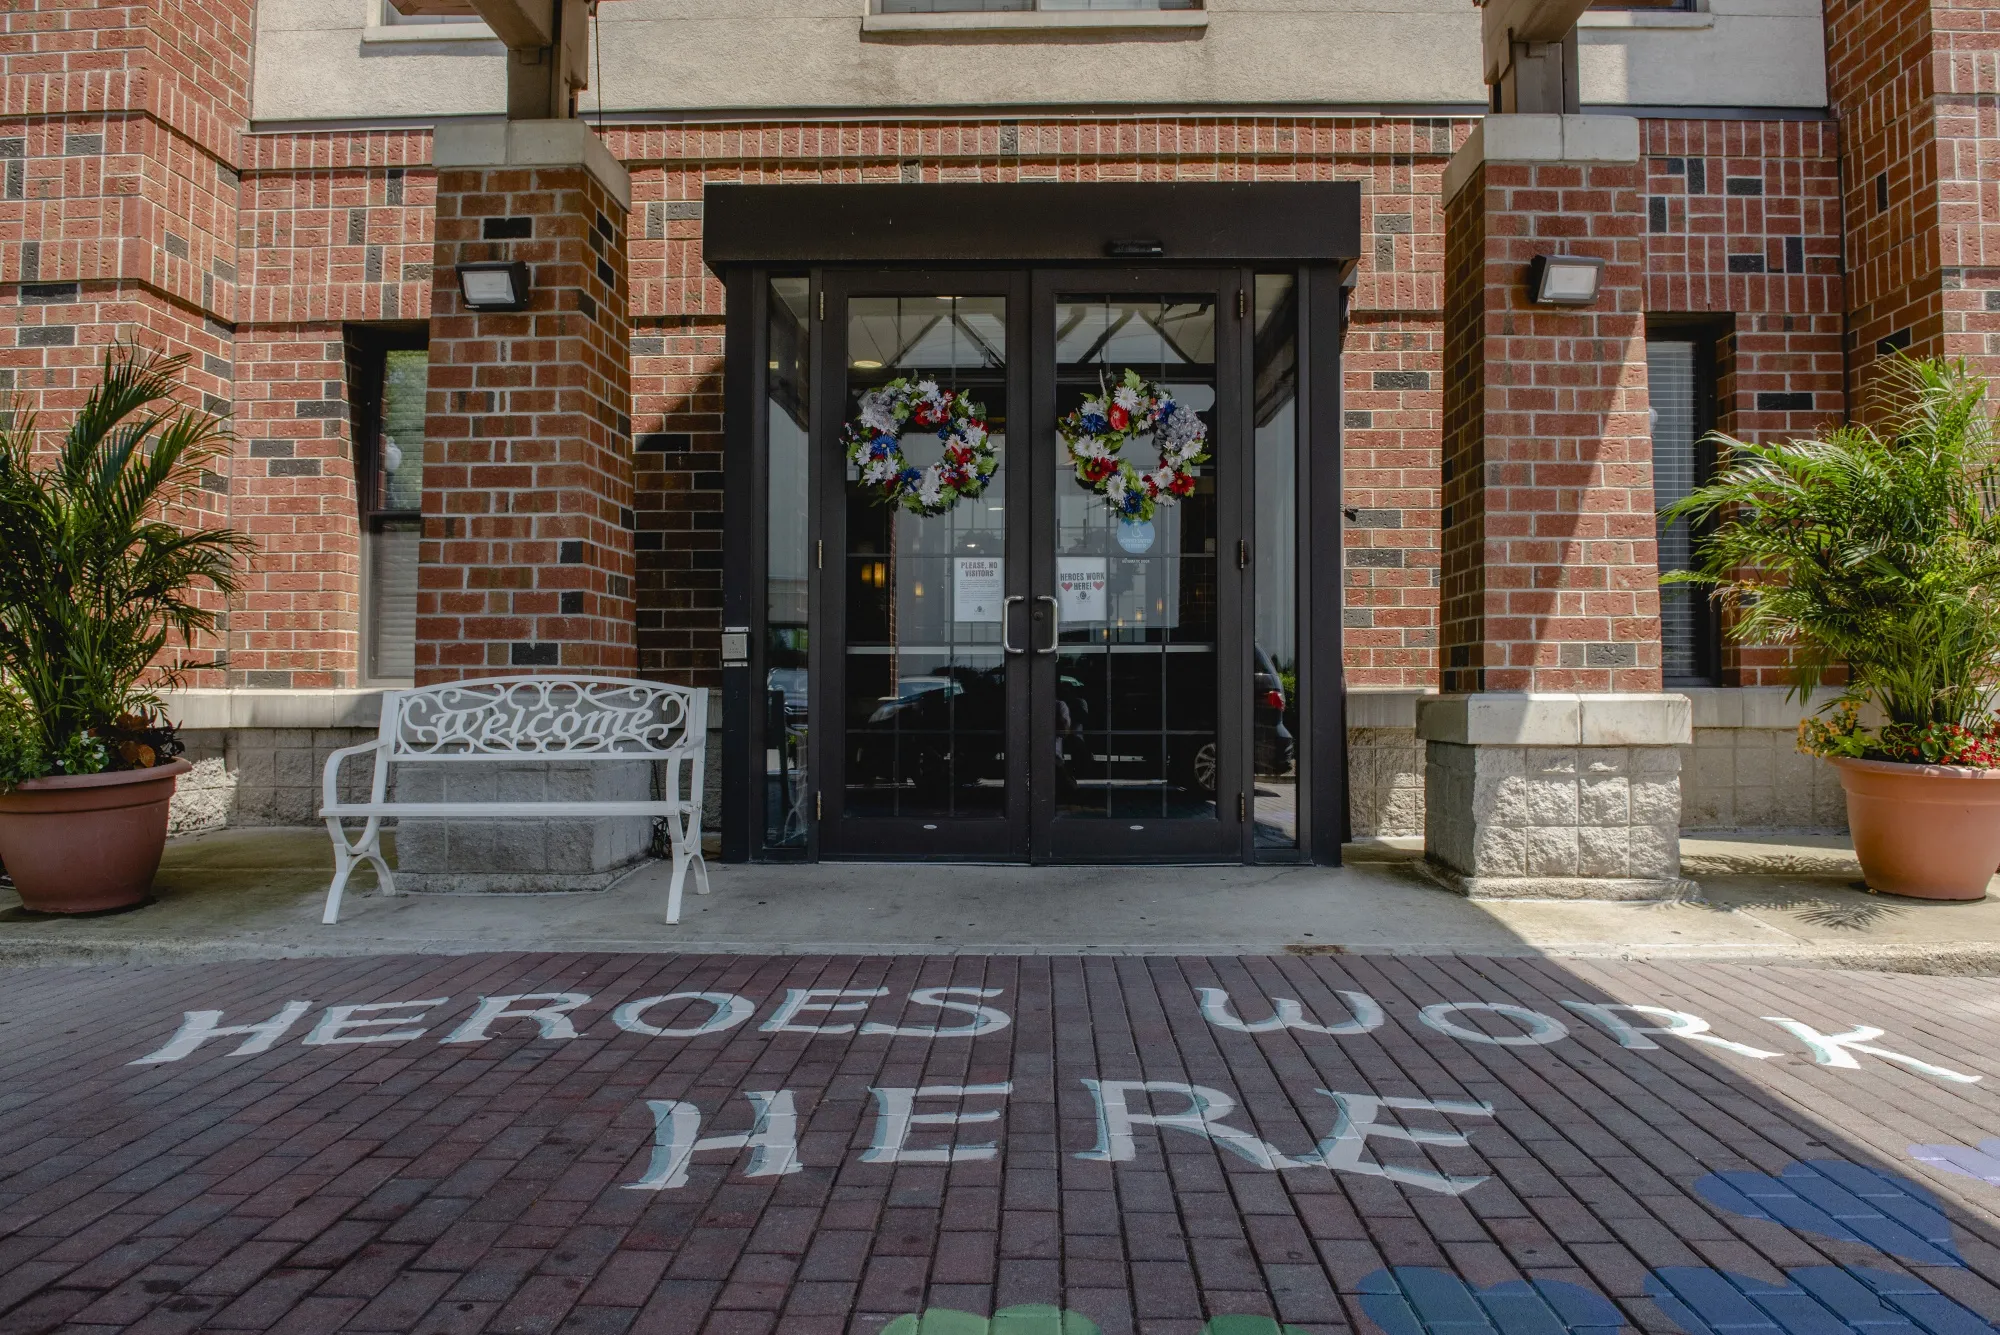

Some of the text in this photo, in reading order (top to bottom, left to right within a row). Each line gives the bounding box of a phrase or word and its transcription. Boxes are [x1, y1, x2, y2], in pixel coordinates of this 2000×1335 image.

[960, 561, 998, 569] PLEASE, NO
[1060, 572, 1105, 581] HEROES WORK
[1073, 582, 1092, 591] HERE!
[125, 986, 1983, 1083] HEROES WORK
[621, 1078, 1496, 1195] HERE
